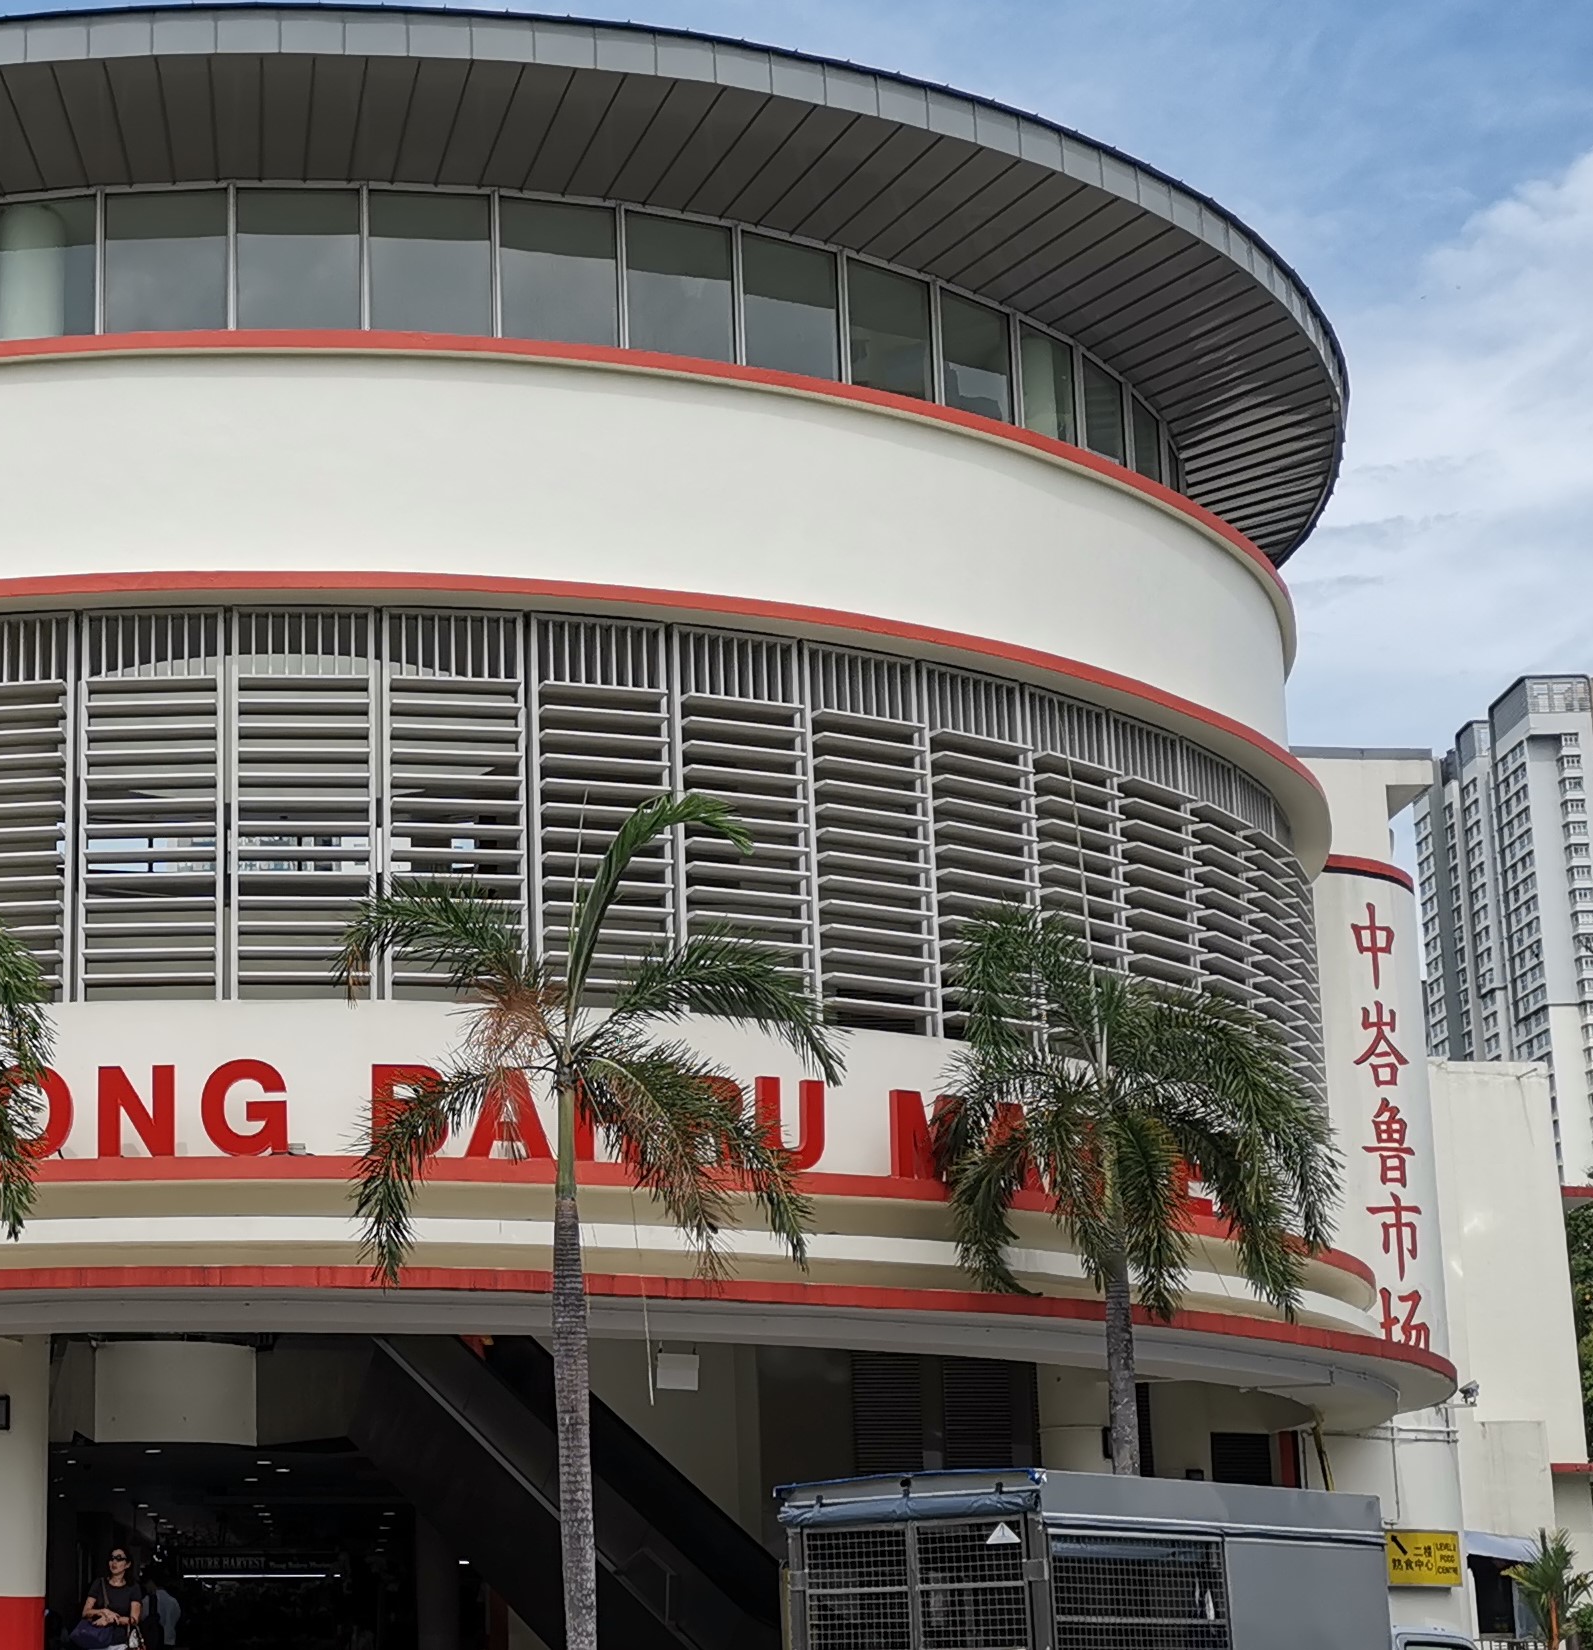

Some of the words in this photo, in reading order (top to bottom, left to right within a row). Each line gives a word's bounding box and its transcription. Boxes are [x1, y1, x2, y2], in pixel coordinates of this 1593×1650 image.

[1351, 902, 1431, 1351] 中峇鲁市场
